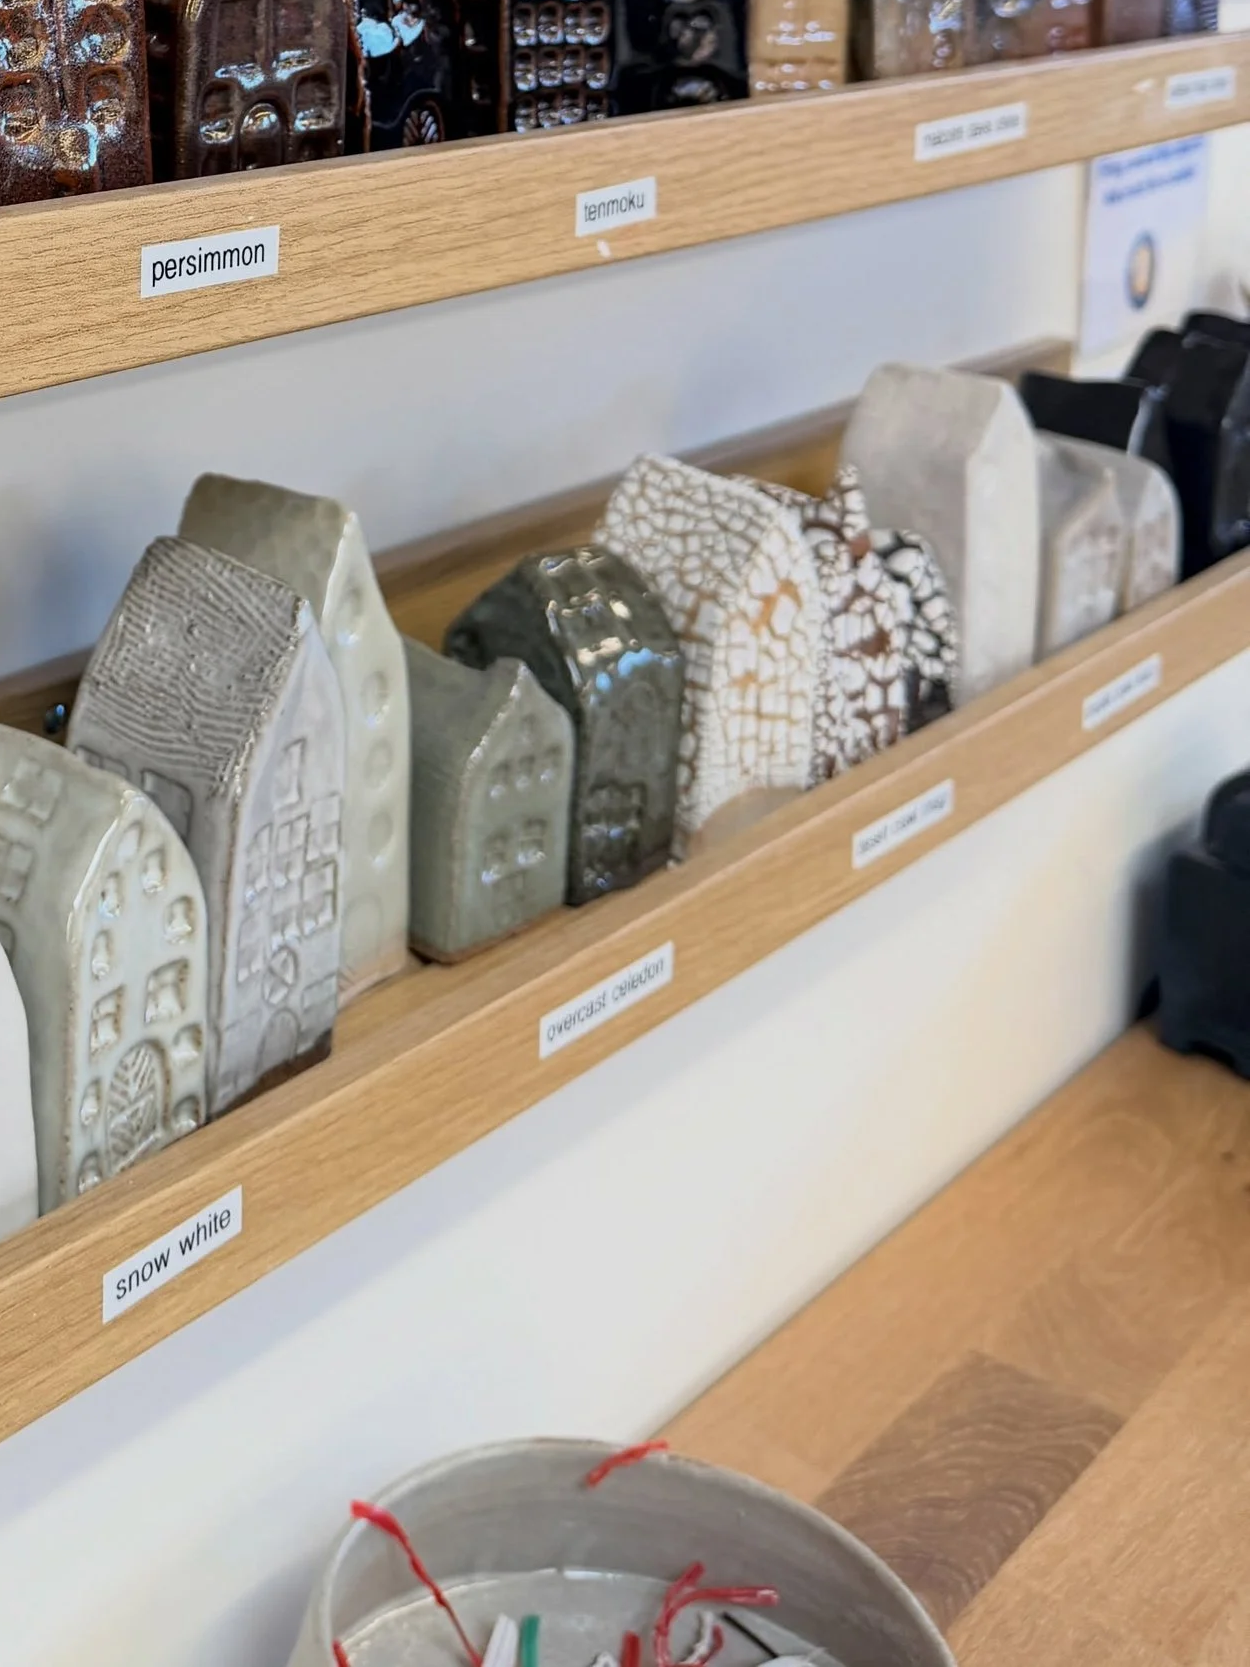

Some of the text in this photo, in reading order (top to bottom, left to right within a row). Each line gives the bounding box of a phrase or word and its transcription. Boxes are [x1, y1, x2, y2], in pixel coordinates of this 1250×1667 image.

[584, 190, 645, 223] tenmoku
[152, 243, 266, 287] persimmon
[547, 990, 607, 1042] overcast
[115, 1209, 231, 1300] snow white
